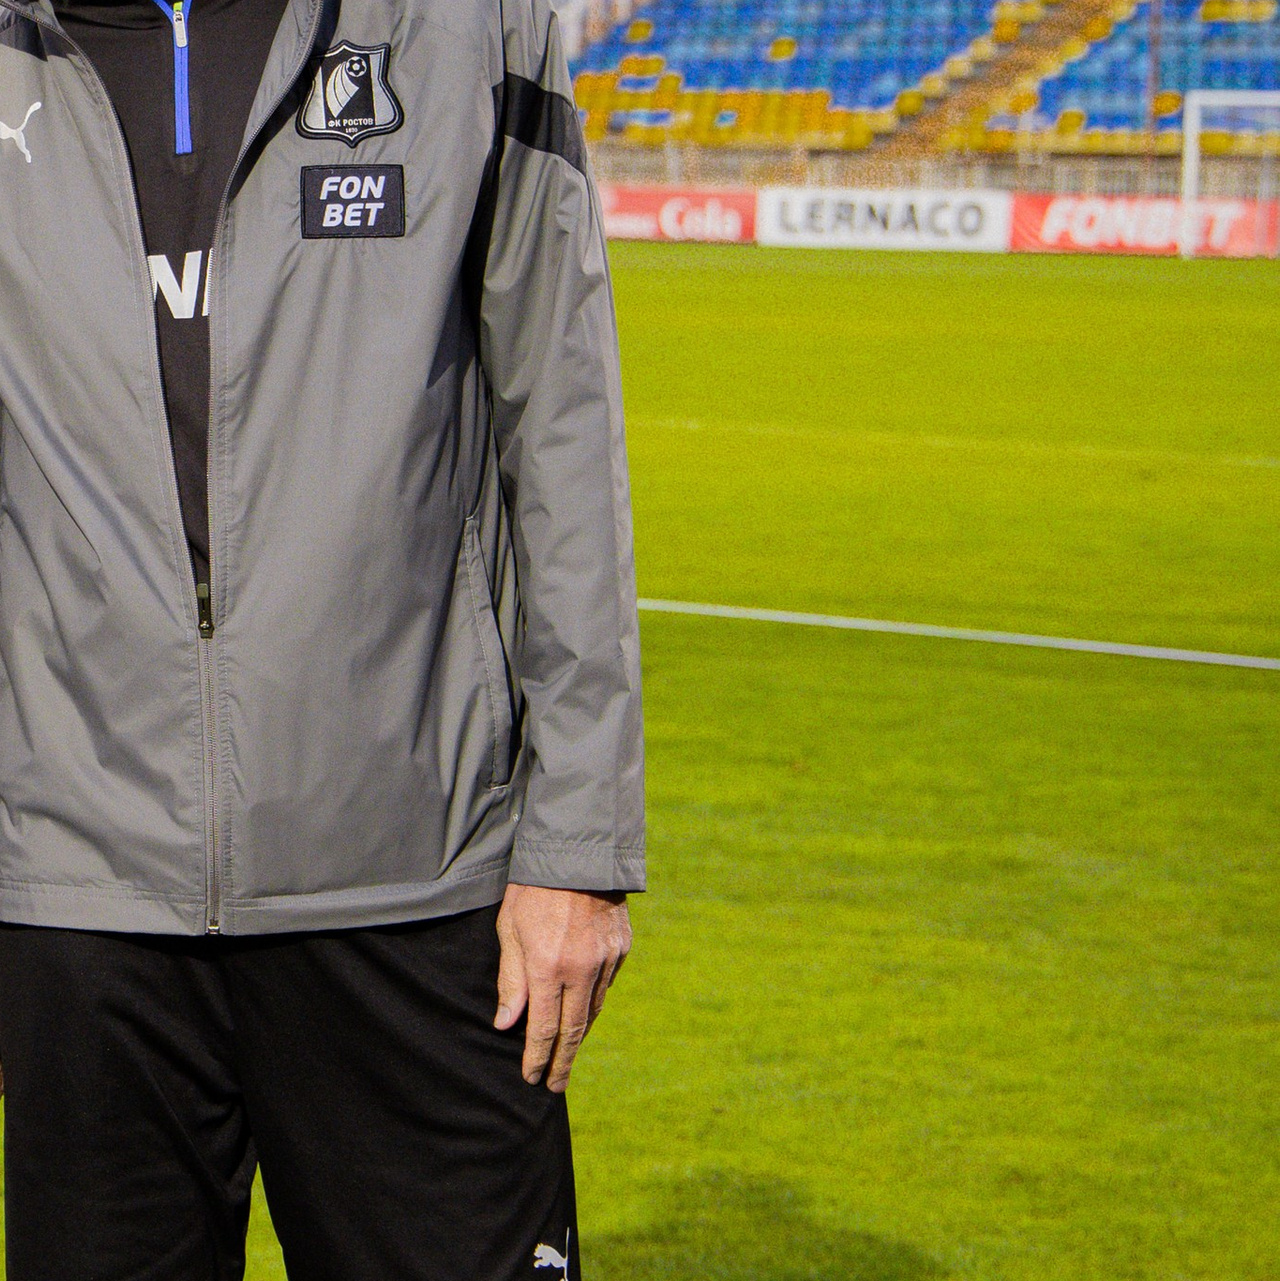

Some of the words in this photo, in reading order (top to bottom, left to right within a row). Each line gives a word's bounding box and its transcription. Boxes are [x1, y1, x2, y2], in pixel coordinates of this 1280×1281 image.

[342, 117, 374, 126] РОСТОВ
[320, 175, 386, 200] FON
[322, 202, 385, 227] BET
[778, 198, 986, 237] LERNACO
